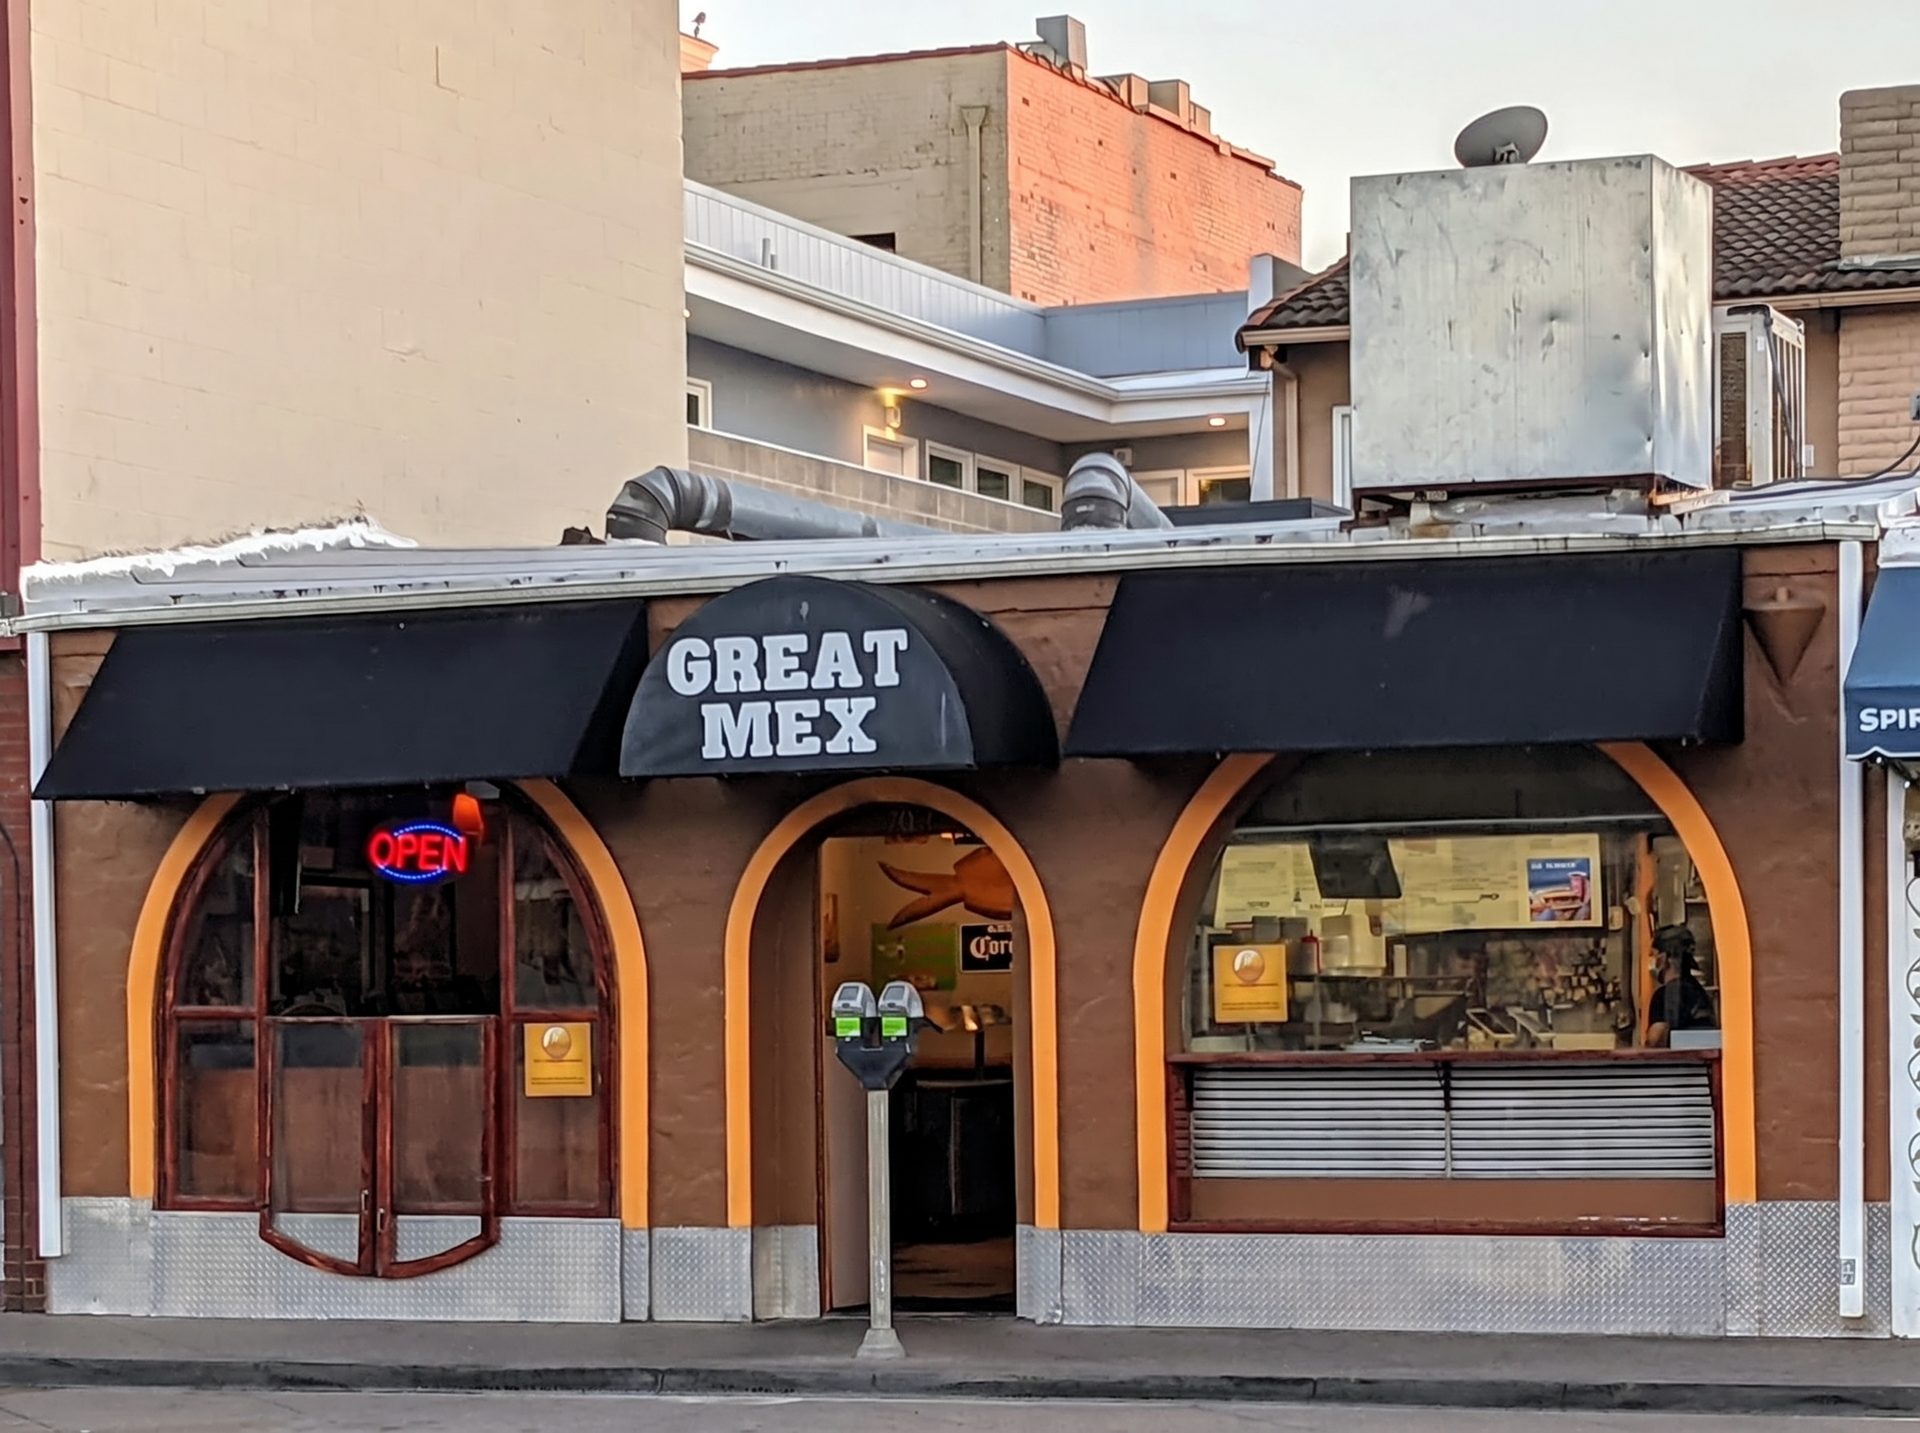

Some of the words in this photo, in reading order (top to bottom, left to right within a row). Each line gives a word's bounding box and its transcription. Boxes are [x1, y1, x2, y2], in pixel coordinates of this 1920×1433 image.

[666, 628, 909, 697] GREAT
[700, 696, 878, 760] MEX
[369, 831, 468, 873] OPEN
